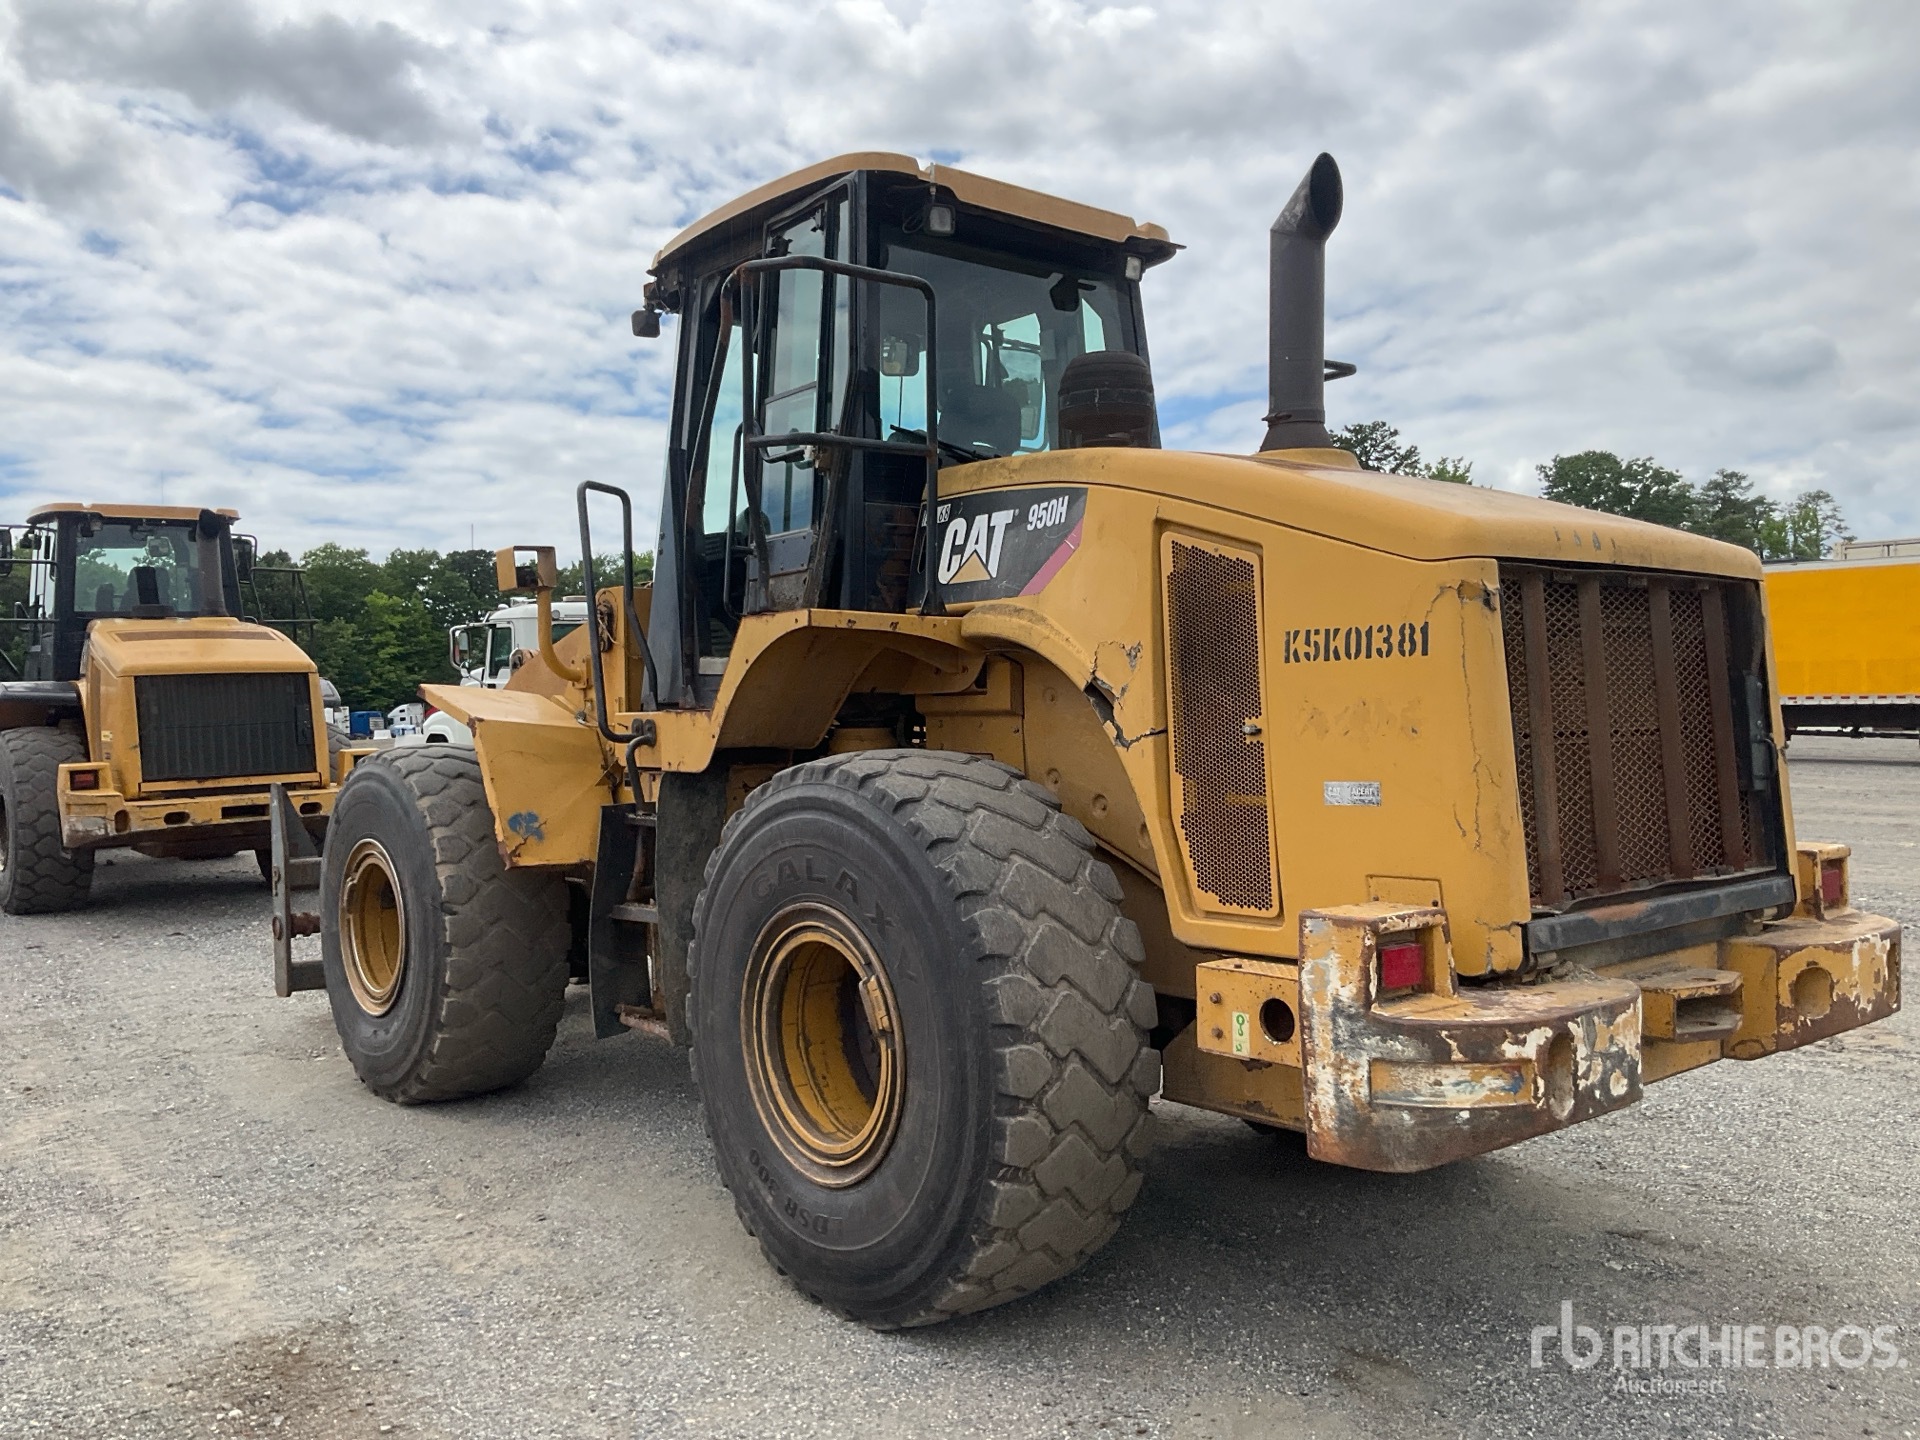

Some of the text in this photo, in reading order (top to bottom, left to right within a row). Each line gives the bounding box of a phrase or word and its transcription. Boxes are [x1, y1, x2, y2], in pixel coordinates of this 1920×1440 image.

[1027, 496, 1069, 531] 950H
[937, 510, 1014, 584] CAT
[1284, 621, 1430, 664] K5K01381
